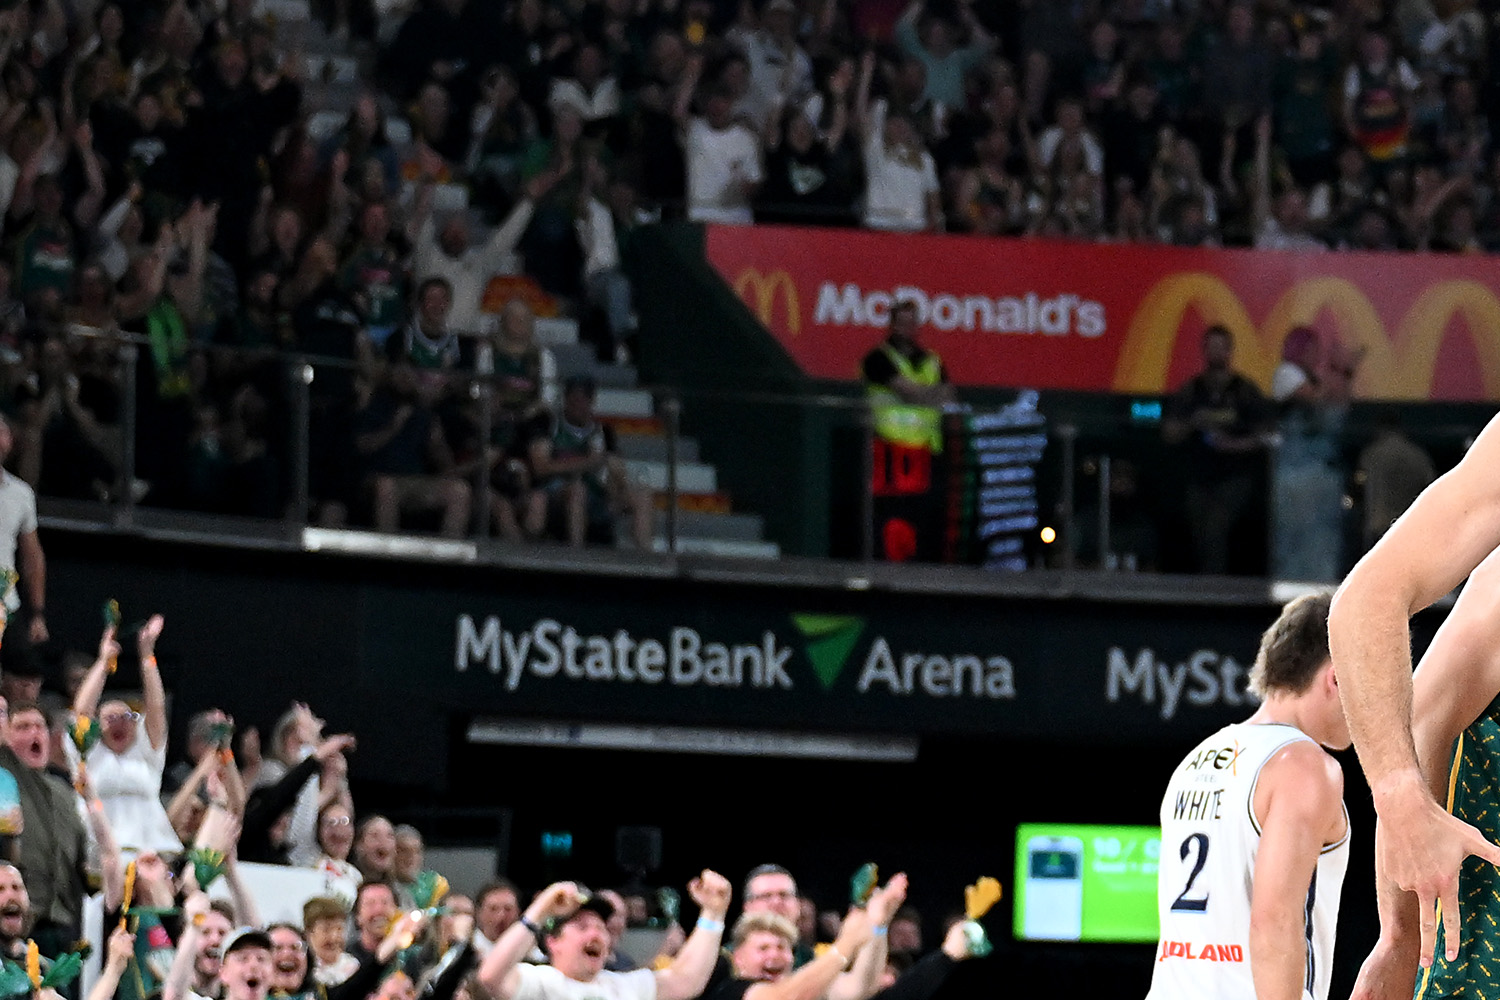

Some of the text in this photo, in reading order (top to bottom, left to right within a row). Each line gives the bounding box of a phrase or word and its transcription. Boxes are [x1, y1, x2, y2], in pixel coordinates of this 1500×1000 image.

[814, 279, 1106, 338] McDonald's
[455, 613, 1016, 699] MyStateBank Arena
[1105, 647, 1261, 720] MySt
[1185, 739, 1247, 777] APEX
[1173, 789, 1225, 821] WHITE
[1170, 833, 1211, 914] 2
